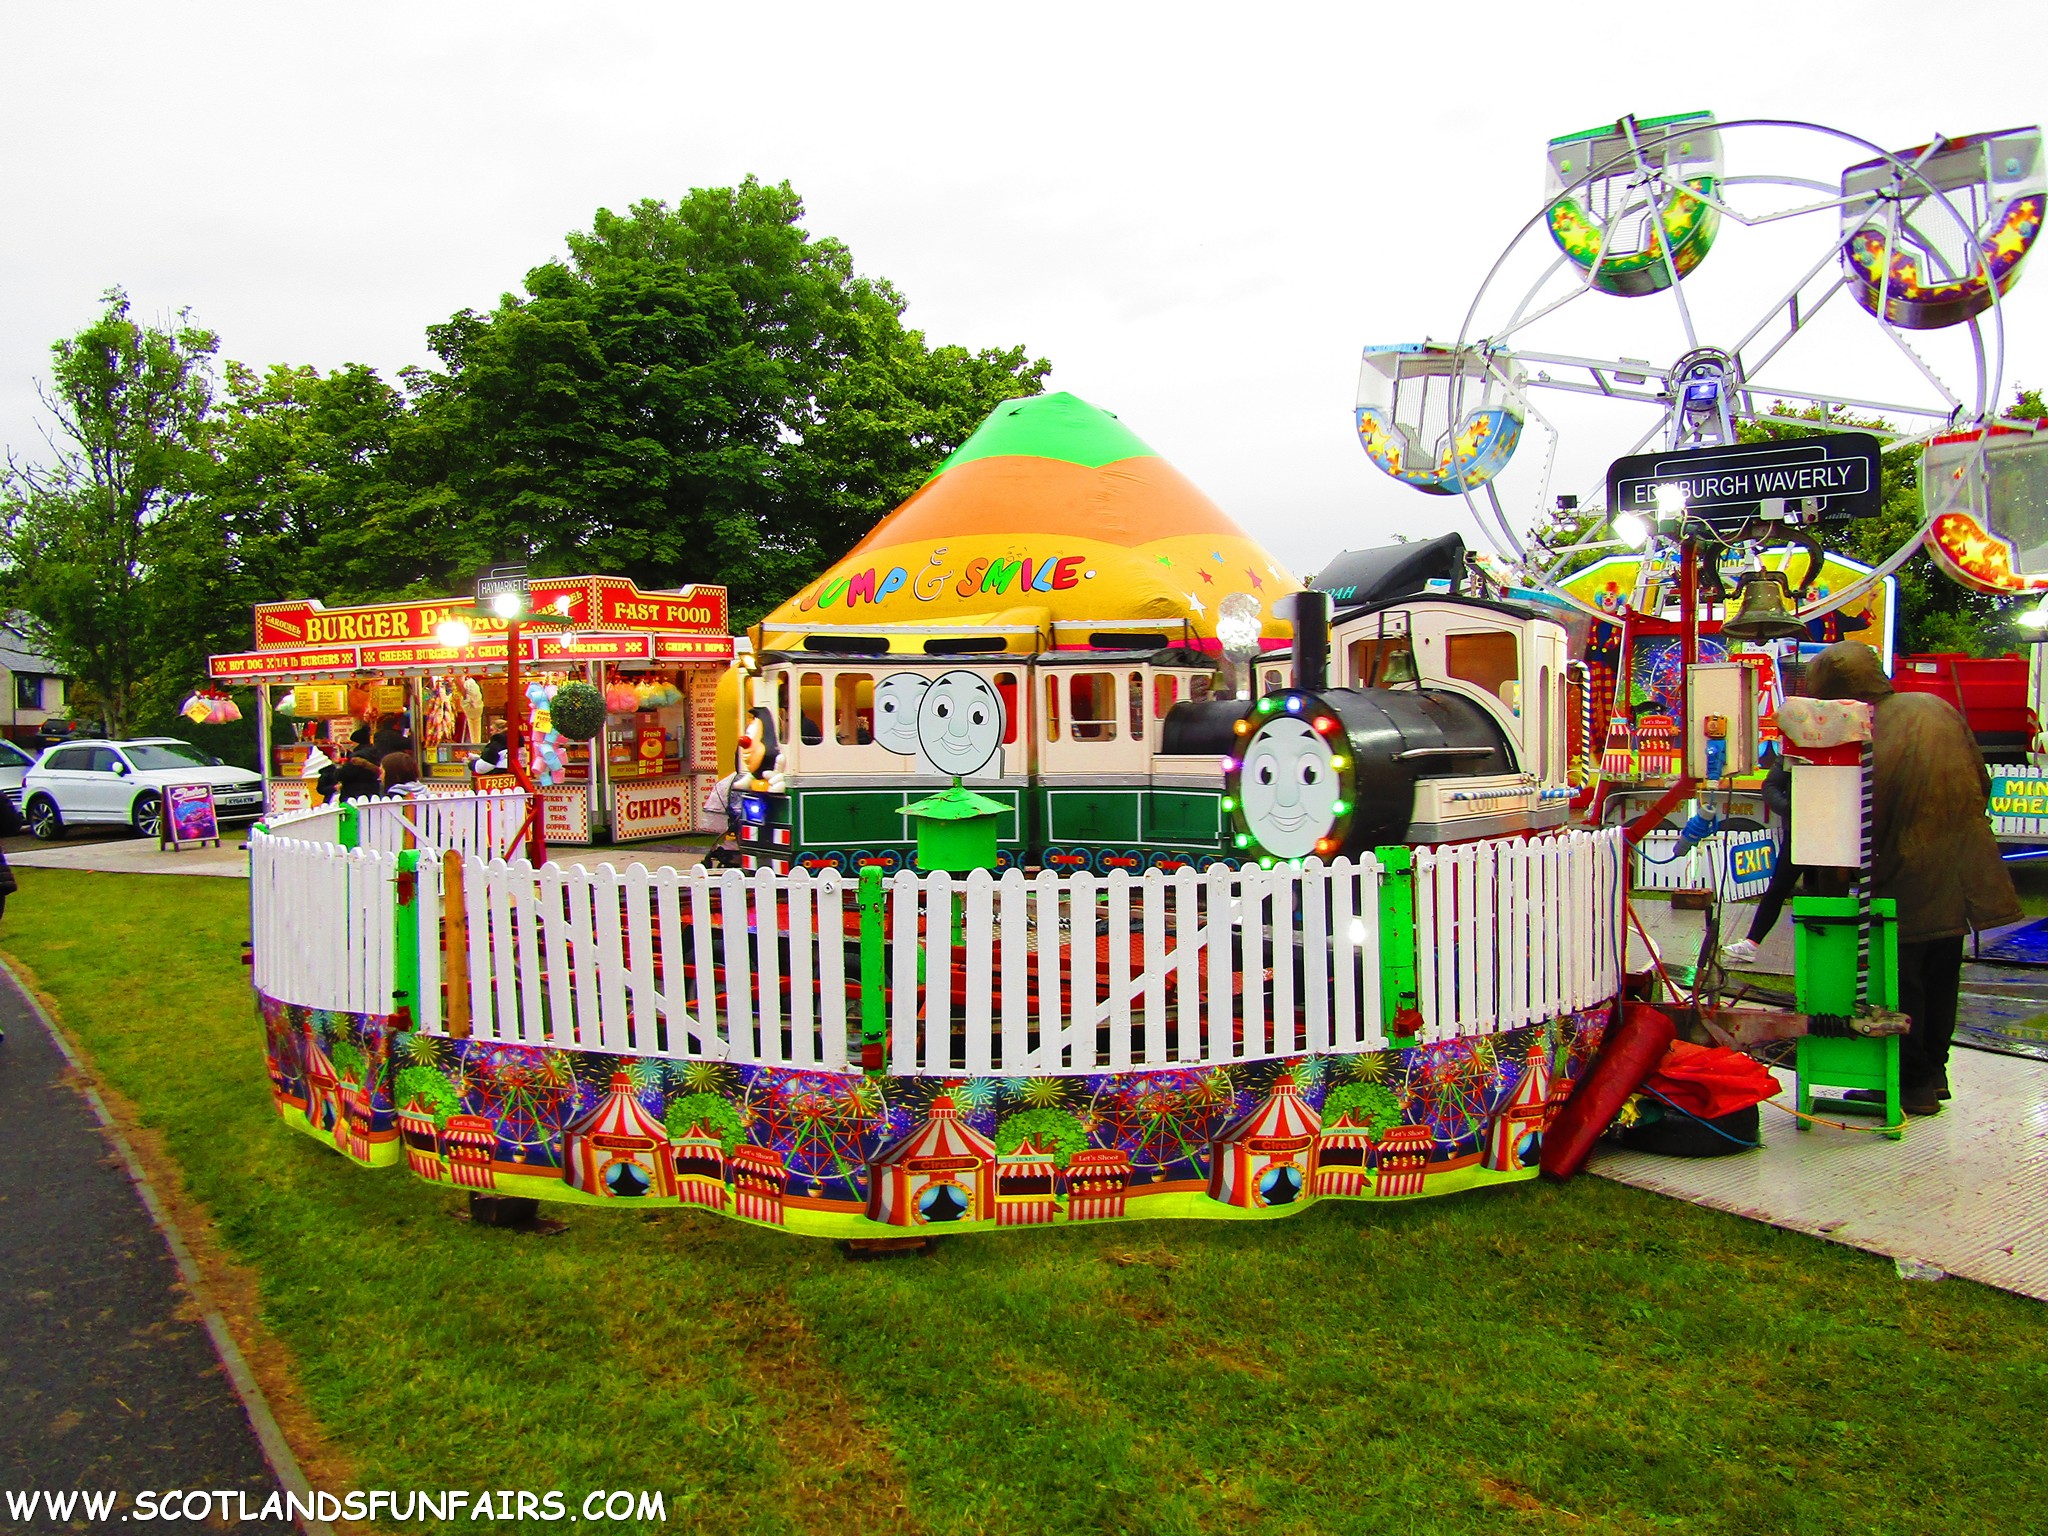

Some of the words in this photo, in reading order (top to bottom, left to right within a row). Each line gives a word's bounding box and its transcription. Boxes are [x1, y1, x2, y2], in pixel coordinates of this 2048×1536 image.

[1634, 475, 1749, 504] EDBURGH
[1754, 465, 1851, 493] WAVERLY
[481, 579, 522, 594] HAYMARKET
[800, 566, 908, 612] JUMP
[914, 547, 954, 601] &
[957, 556, 1085, 597] SMILE
[1325, 585, 1358, 600] OAH
[535, 590, 583, 615] CAREL
[614, 602, 660, 621] FAST
[666, 605, 711, 624] FOOD
[265, 615, 302, 635] CAROUSEL
[305, 613, 410, 643] BURGER
[379, 649, 413, 662] CHEESE
[416, 647, 459, 660] BURGERS
[478, 644, 509, 657] CHIPS
[568, 642, 618, 653] DRINKS
[665, 642, 693, 652] CHIPS
[704, 643, 725, 653] DIPS
[229, 660, 245, 671] HOT
[247, 659, 263, 670] DOG
[301, 654, 340, 667] BURGERS
[643, 730, 661, 738] Fresh
[486, 777, 517, 789] FRESH
[626, 796, 682, 821] CHIPS
[1991, 797, 2048, 814] WHE
[1735, 846, 1773, 876] EXIT
[1407, 1129, 1425, 1137] Shoot
[740, 1148, 755, 1157] Let's
[1078, 1154, 1096, 1162] Let's
[920, 1159, 966, 1170] Circus
